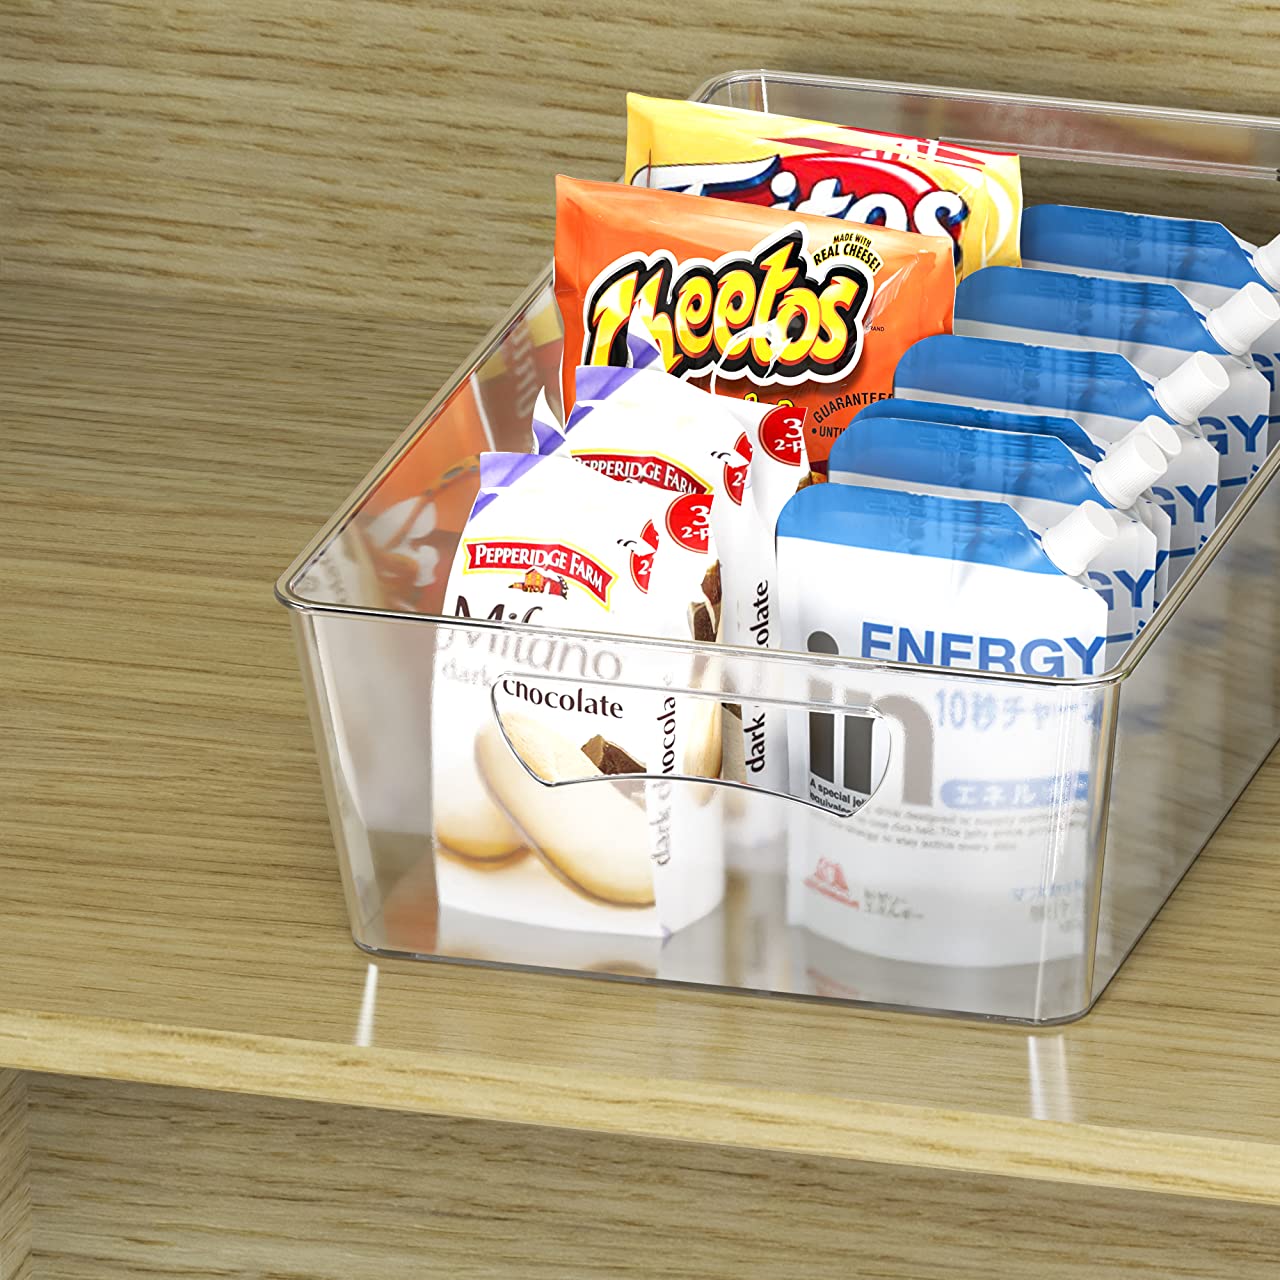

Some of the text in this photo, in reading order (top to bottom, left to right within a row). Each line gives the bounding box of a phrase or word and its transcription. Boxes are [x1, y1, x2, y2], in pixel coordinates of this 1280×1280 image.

[813, 243, 881, 272] REAL CHEESE!
[833, 233, 872, 247] MADE WITH
[474, 544, 604, 590] PEPPERIDGE FARM
[861, 621, 1107, 678] ENERGY
[744, 712, 766, 773] dark
[819, 783, 851, 804] special
